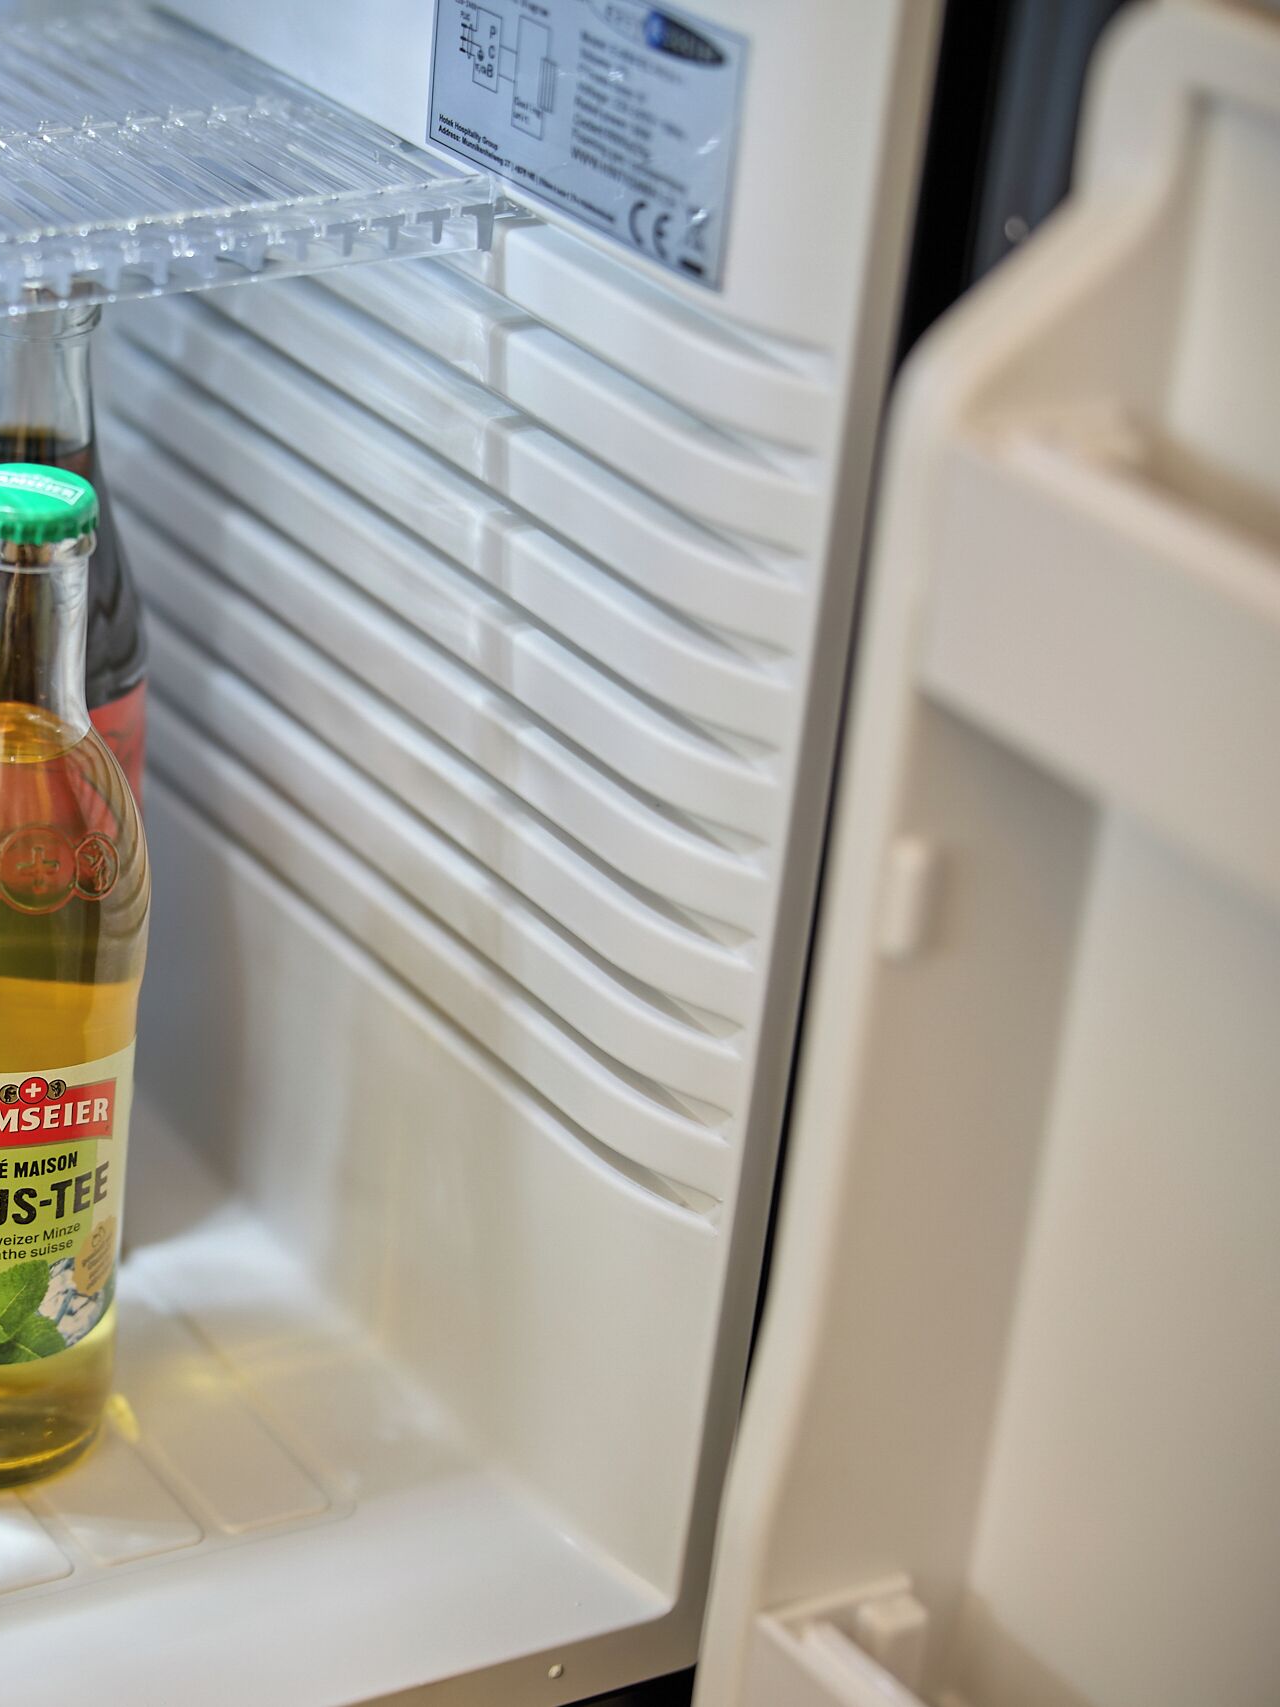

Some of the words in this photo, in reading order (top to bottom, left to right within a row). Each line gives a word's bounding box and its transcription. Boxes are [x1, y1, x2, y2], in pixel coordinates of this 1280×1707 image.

[438, 125, 462, 144] Address:
[454, 119, 482, 144] Hospitality
[482, 135, 499, 151] Group
[14, 1151, 78, 1179] MAISON
[42, 1221, 82, 1241] Minze
[30, 1238, 74, 1258] suisse
